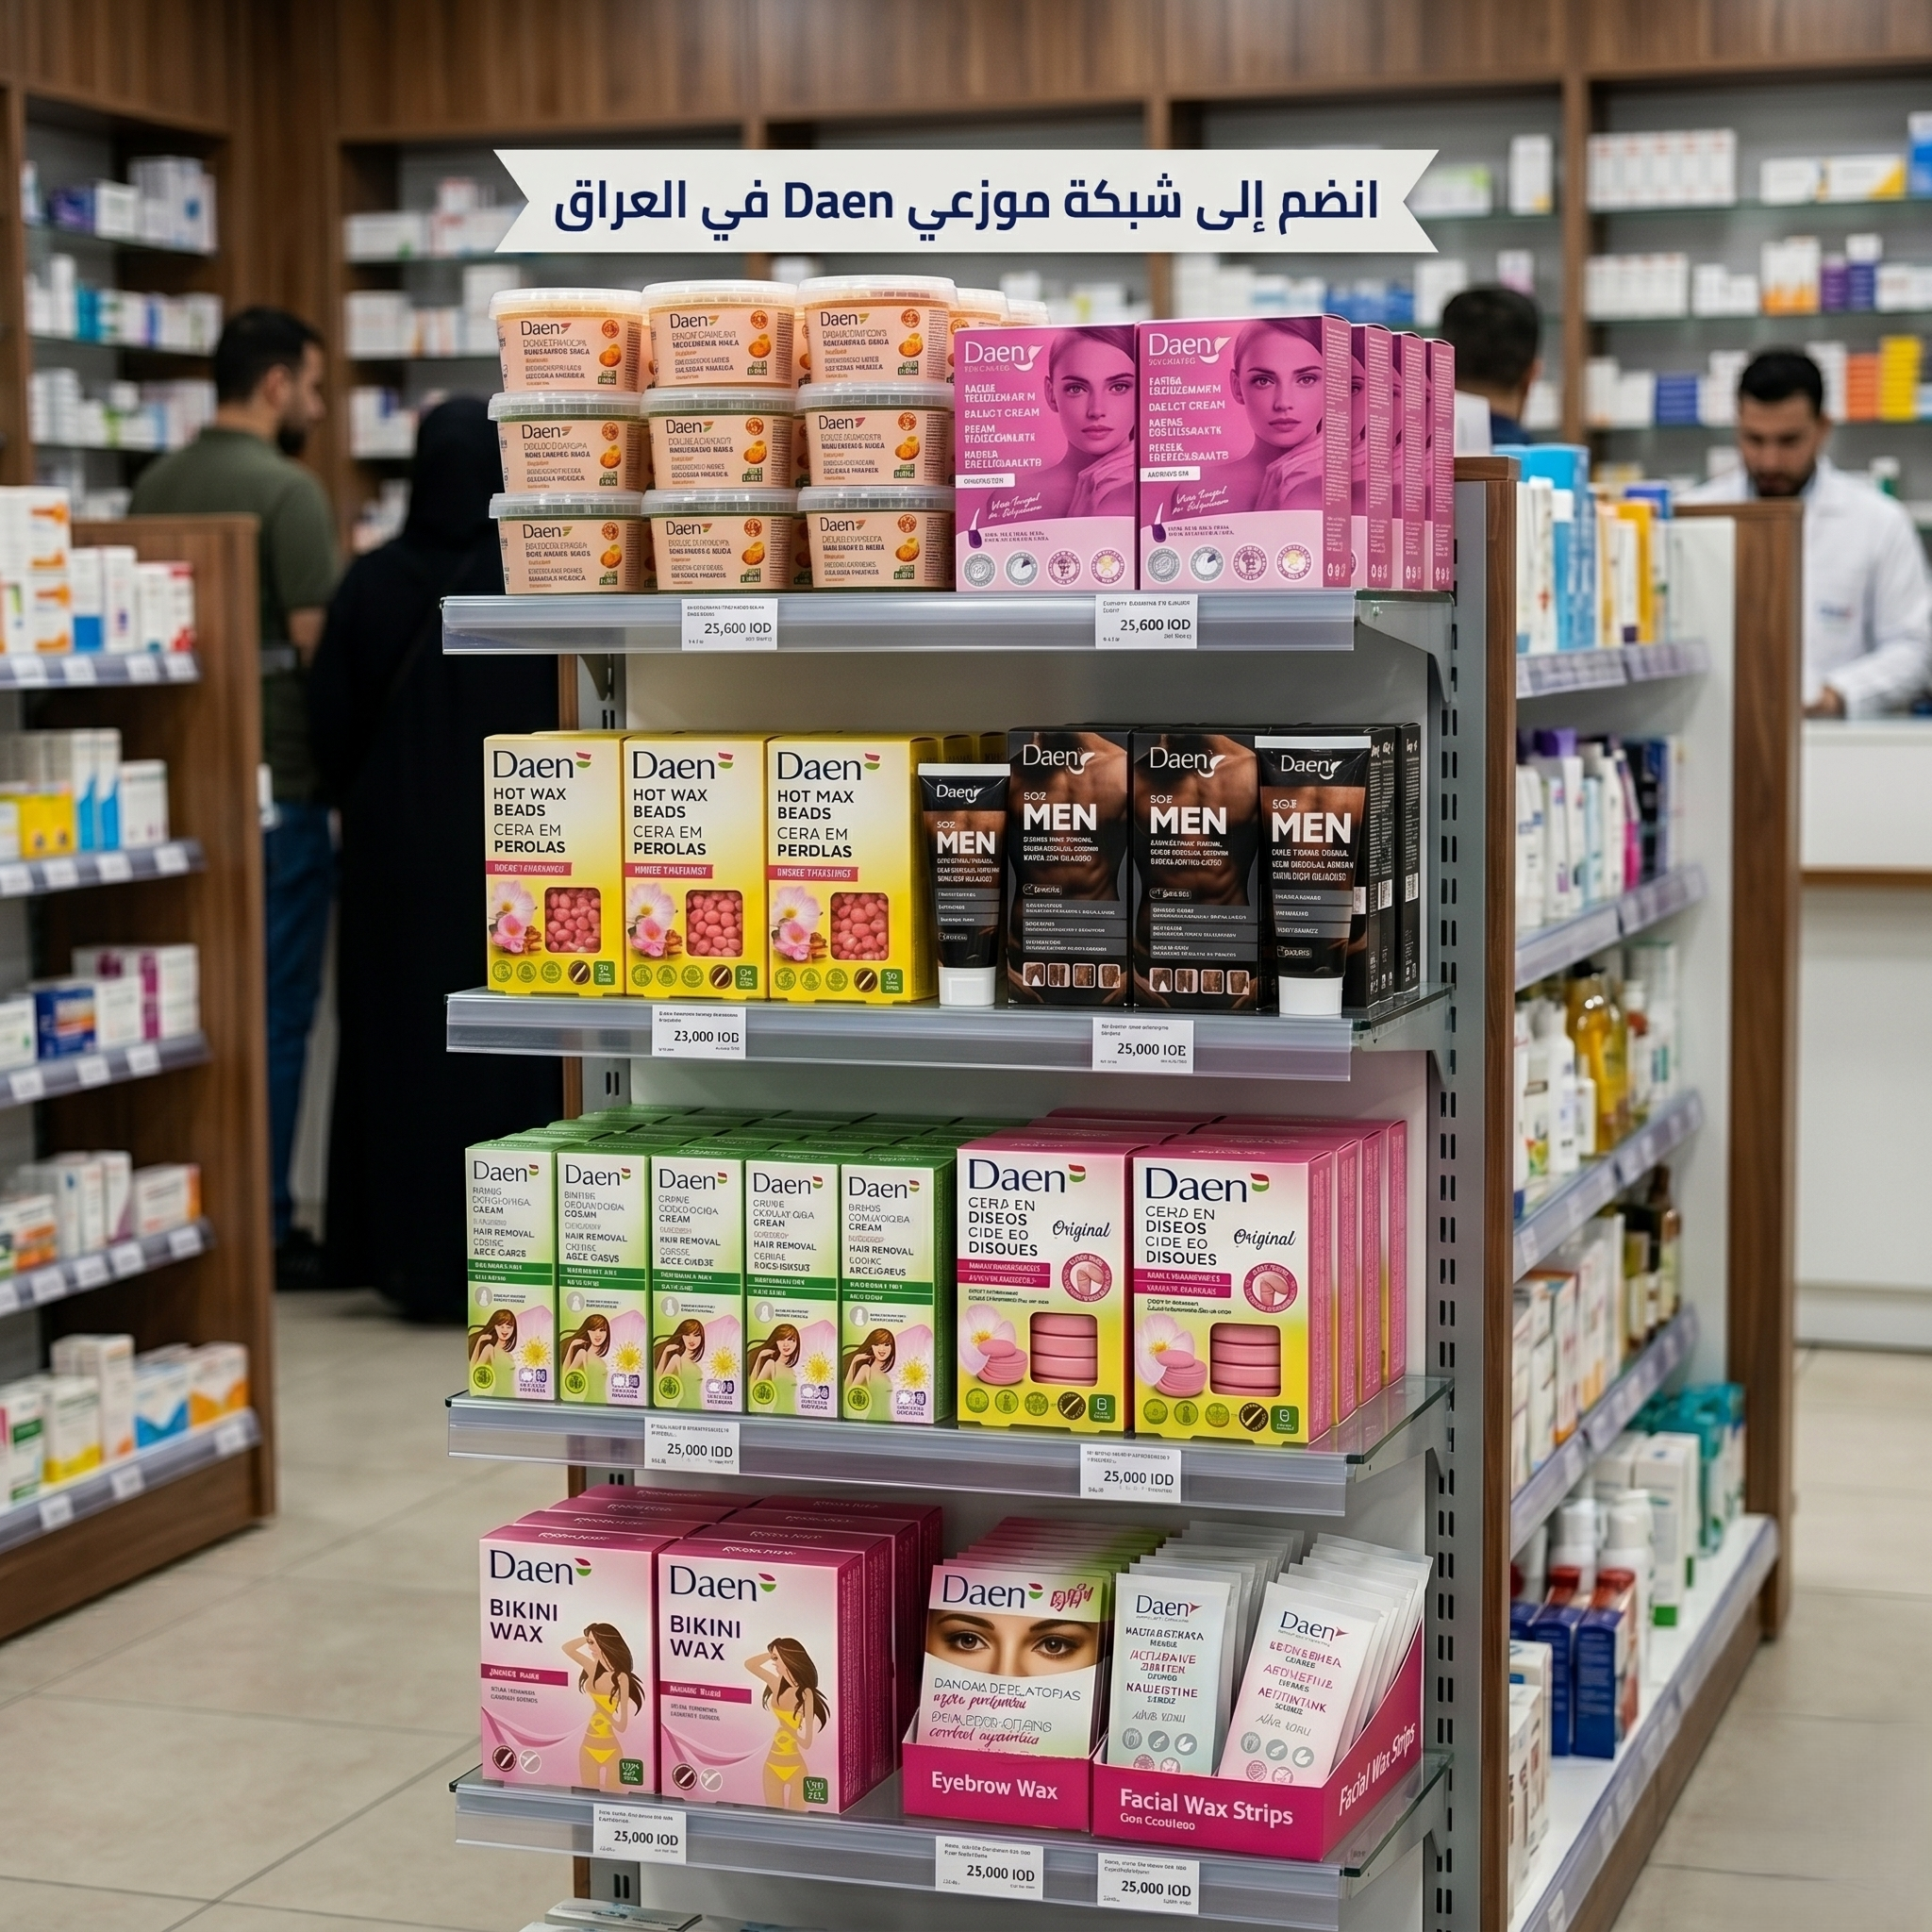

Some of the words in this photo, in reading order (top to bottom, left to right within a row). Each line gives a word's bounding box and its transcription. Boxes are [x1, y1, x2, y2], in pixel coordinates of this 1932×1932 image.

[670, 313, 708, 329] Daen
[820, 311, 858, 327] Daen
[521, 320, 560, 336] Daen
[964, 341, 1024, 363] Daen
[1149, 333, 1211, 357] Daen
[1004, 408, 1041, 418] CREAM
[1189, 400, 1226, 411] CREAM
[666, 419, 703, 434] Daen
[818, 414, 855, 430] Daen
[522, 424, 561, 440] Daen
[523, 524, 562, 539] Daen
[666, 521, 702, 536] Daen
[820, 516, 856, 532] Daen
[705, 622, 746, 637] 25,600
[749, 622, 772, 634] IOD
[1120, 619, 1165, 634] 25,600
[1167, 619, 1191, 630] IOD
[1023, 743, 1078, 766] Daen
[1149, 746, 1208, 770] Daen
[492, 750, 575, 779] Daen
[633, 750, 715, 780] Daen
[777, 751, 862, 781] Daen
[1280, 755, 1330, 774] Daen
[493, 787, 525, 800] HOT
[530, 788, 567, 801] WAX
[633, 789, 666, 802] HOT
[671, 789, 708, 802] WAX
[777, 790, 811, 803] HOT
[816, 791, 855, 804] MAX
[936, 784, 974, 799] Daen
[493, 804, 546, 817] BEADS
[633, 805, 687, 819] BEADS
[777, 807, 832, 821] BEADS
[1024, 803, 1098, 831] MEN
[1150, 806, 1227, 835] MEN
[1273, 811, 1352, 844] MEN
[493, 823, 535, 837] CERA
[540, 824, 562, 837] EM
[633, 824, 675, 839] CERA
[679, 825, 703, 839] EM
[777, 826, 821, 841] CERA
[825, 827, 849, 841] EM
[494, 840, 566, 854] PEROLAS
[633, 841, 707, 856] PEROLAS
[937, 830, 996, 855] MEN
[674, 1030, 714, 1044] 23,000
[1117, 1042, 1159, 1057] 25,000
[473, 1160, 528, 1183] Daen
[565, 1163, 621, 1187] Daen
[658, 1168, 717, 1191] Daen
[968, 1158, 1066, 1194] Daen
[753, 1172, 811, 1195] Daen
[848, 1175, 908, 1199] Daen
[1145, 1167, 1248, 1203] Daen
[1014, 1199, 1036, 1212] EN
[658, 1214, 691, 1224] CREAM
[968, 1210, 1028, 1226] DISEOS
[1193, 1208, 1216, 1221] EN
[473, 1227, 493, 1236] HAIR
[494, 1228, 536, 1239] REMOVAL
[848, 1223, 883, 1232] CREAM
[968, 1226, 1005, 1241] CIDE
[1008, 1228, 1030, 1241] EO
[1052, 1220, 1112, 1243] Original
[1145, 1220, 1208, 1236] DISEOS
[586, 1232, 628, 1243] REMOVAL
[679, 1237, 722, 1247] REMOVAL
[1145, 1236, 1183, 1249] CIDE
[1187, 1238, 1208, 1250] EO
[1233, 1228, 1297, 1251] Original
[753, 1240, 774, 1250] HAIR
[775, 1241, 818, 1252] REMOVAL
[849, 1244, 871, 1254] HAIR
[666, 1442, 708, 1458] 25,000
[1103, 1470, 1147, 1485] 25,000
[490, 1549, 575, 1587] Daen
[669, 1564, 758, 1603] Daen
[942, 1574, 1026, 1609] Daen
[490, 1598, 558, 1623] BIKINI
[1135, 1594, 1190, 1618] Daen
[490, 1621, 544, 1644] WAX
[670, 1614, 741, 1640] BIKINI
[1279, 1610, 1336, 1642] Daen
[669, 1638, 725, 1661] WAX
[1339, 1762, 1372, 1817] Facial
[1372, 1750, 1391, 1785] Wax
[1391, 1722, 1416, 1765] Strips
[930, 1770, 1012, 1797] Eyebrow
[1016, 1779, 1059, 1801] Wax
[1120, 1788, 1179, 1814] Facial
[1183, 1794, 1229, 1819] Wax
[1232, 1800, 1294, 1829] Strips
[613, 1829, 654, 1845] 25,000
[657, 1833, 679, 1847] IOD
[966, 1864, 1009, 1880] 25,000
[1011, 1869, 1036, 1883] IOD
[1121, 1880, 1164, 1895] 25,000
[1167, 1883, 1191, 1898] IOD
